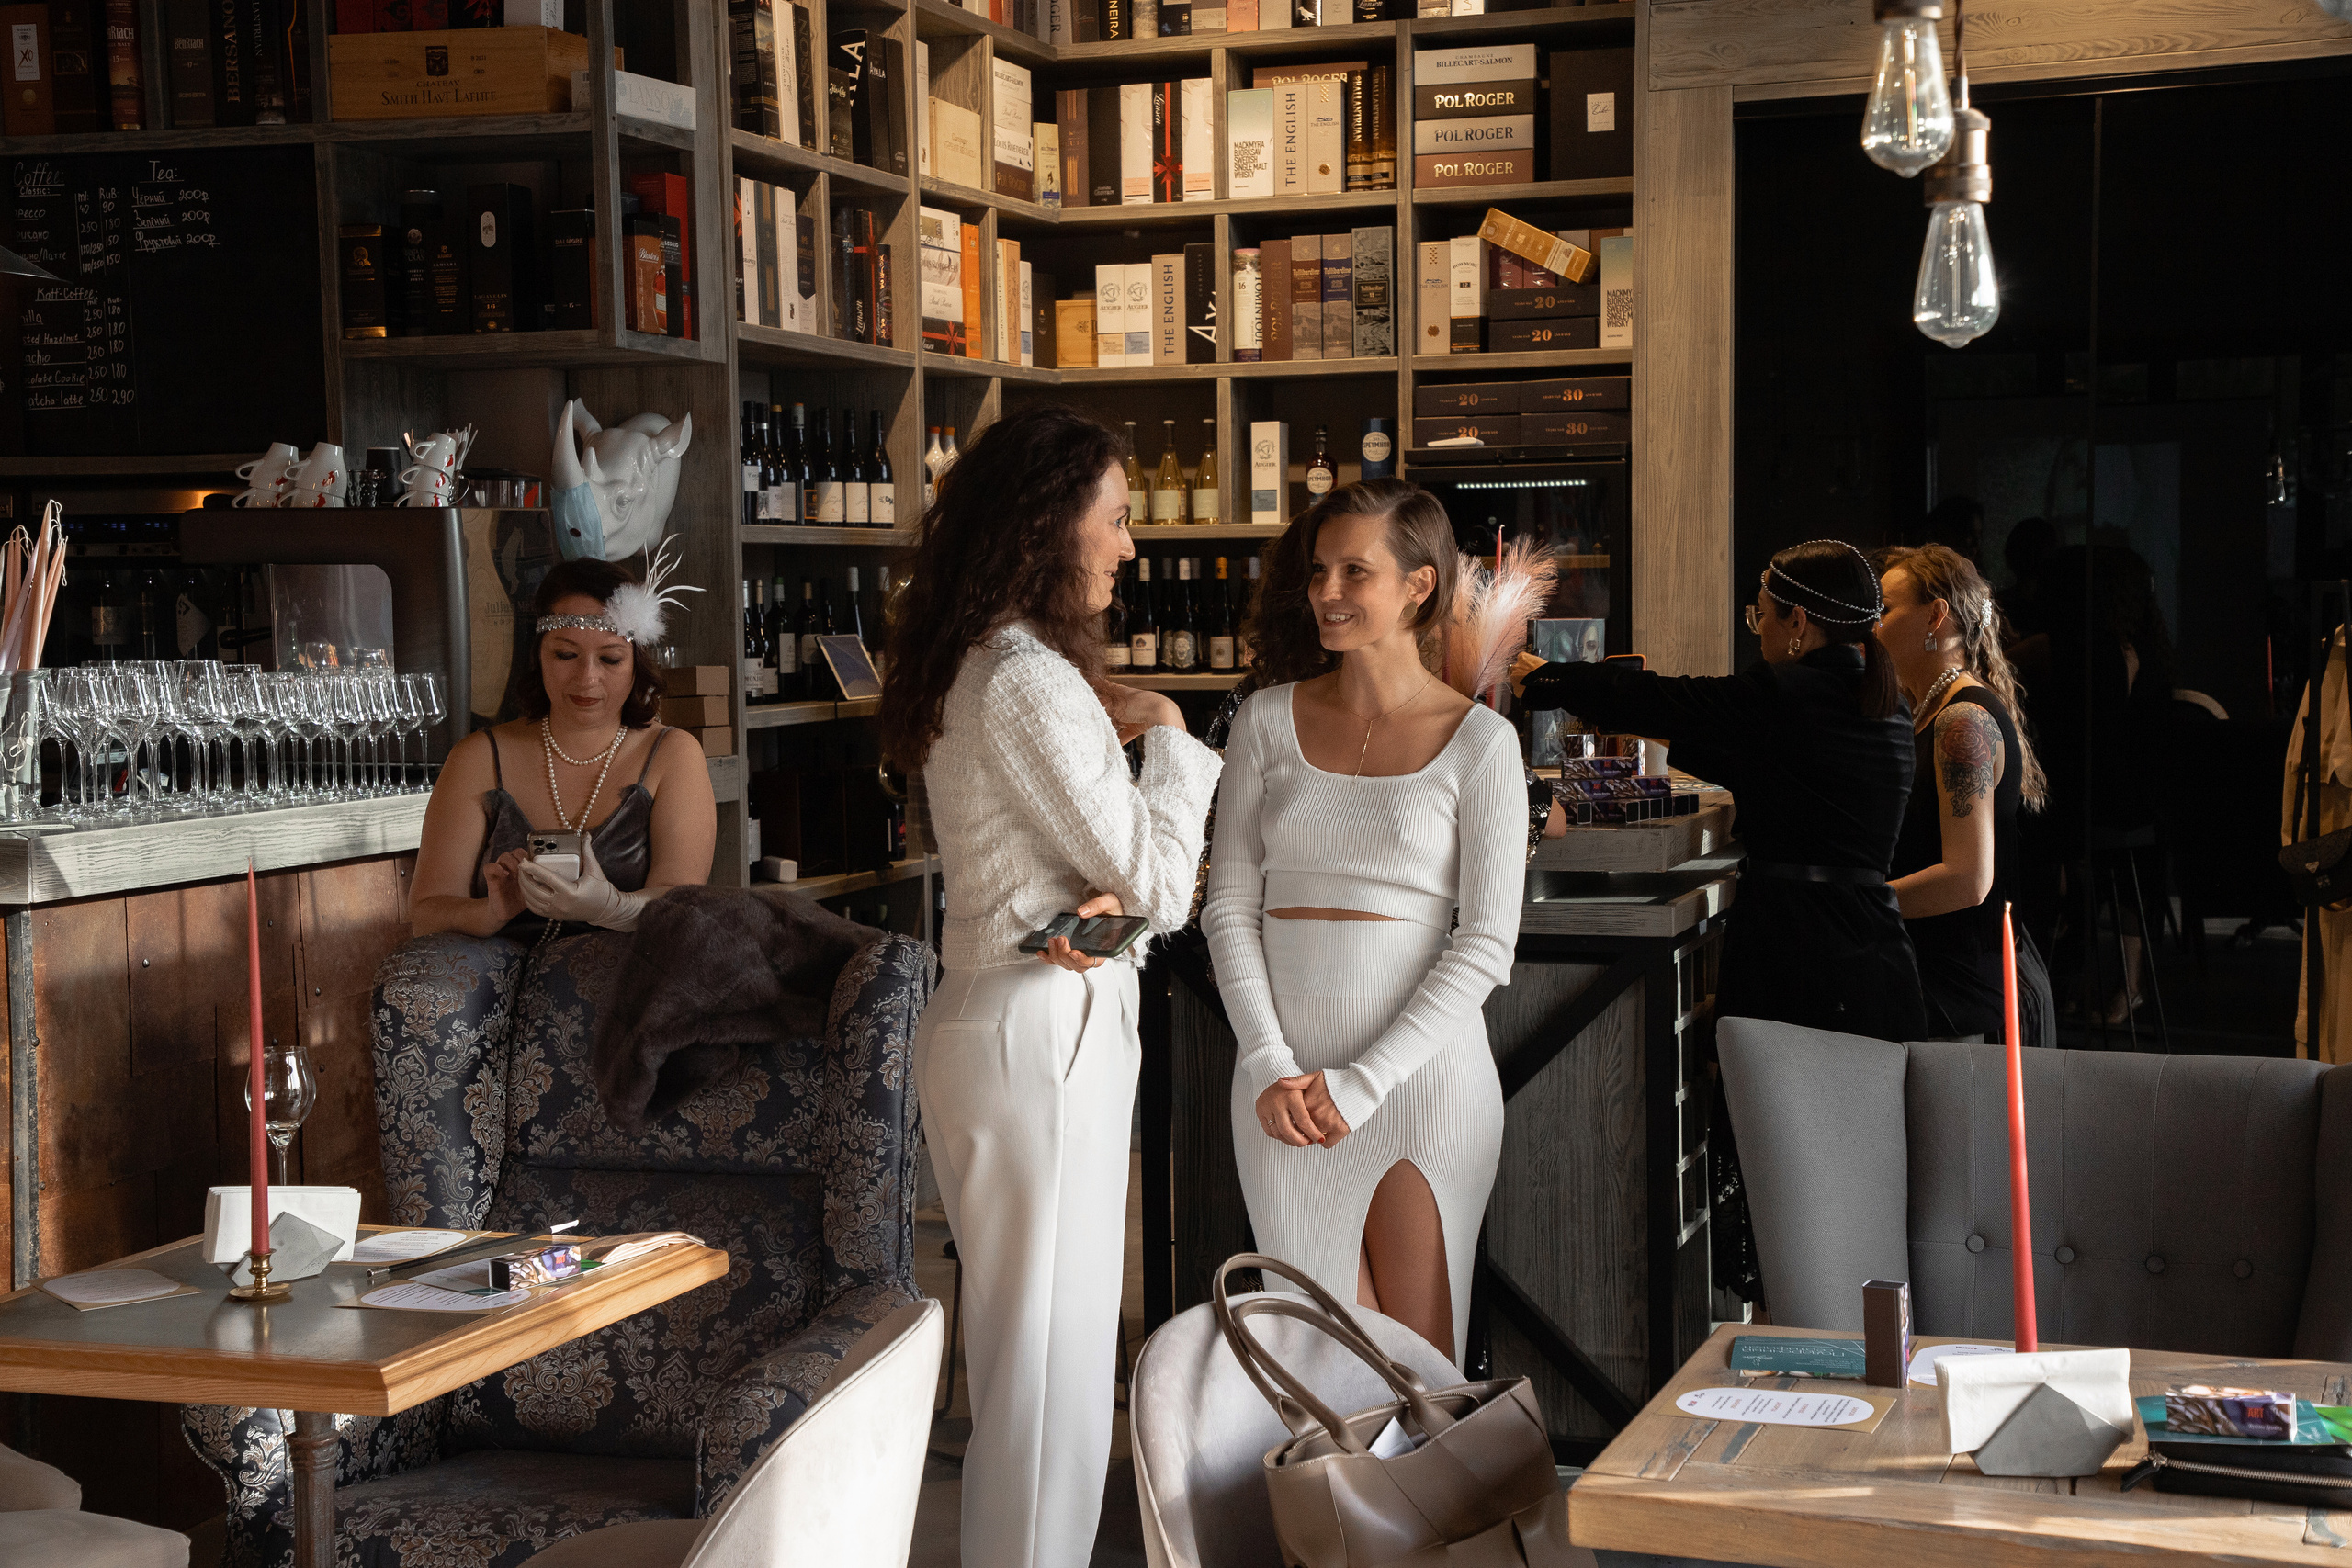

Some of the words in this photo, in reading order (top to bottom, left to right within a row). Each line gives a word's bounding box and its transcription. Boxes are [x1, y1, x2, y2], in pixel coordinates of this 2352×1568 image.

[222, 1, 241, 103] BERSANO
[1436, 57, 1514, 68] BILLECART-SALMON
[381, 90, 418, 106] SMITH
[1434, 94, 1464, 109] POL
[1464, 91, 1515, 107] ROGER
[1285, 92, 1296, 154] ENGLISH
[1435, 129, 1463, 142] POL
[1464, 126, 1514, 141] ROGER
[1234, 141, 1265, 150] MACKMYRA
[1234, 155, 1258, 164] SWEDISH
[1253, 162, 1268, 171] MALT
[149, 160, 178, 182] Tea:
[1234, 171, 1255, 179] WHISKY
[1285, 159, 1296, 187] THE
[1434, 164, 1463, 178] POL
[1464, 161, 1514, 176] ROGER
[102, 201, 115, 213] 90
[81, 221, 98, 233] 250
[105, 218, 120, 231] 180
[106, 235, 119, 248] 150
[107, 254, 121, 265] 150
[1163, 265, 1174, 323] ENGLISH
[1607, 289, 1633, 298] MACKMY
[1534, 296, 1555, 309] 20
[85, 308, 103, 321] 250
[107, 306, 121, 315] 180
[43, 333, 79, 344] Hazelnut
[86, 326, 103, 339] 250
[108, 322, 126, 337] 180
[1532, 329, 1553, 342] 20
[1164, 328, 1174, 356] THE
[25, 349, 51, 364] achio
[87, 346, 105, 360] 250
[109, 340, 124, 354] 180
[54, 370, 85, 384] Cookie
[88, 367, 107, 379] 250
[111, 362, 127, 379] 180
[28, 390, 84, 406] atcha-latte
[89, 386, 108, 403] 250
[111, 389, 135, 405] 290
[1459, 393, 1479, 406] 20
[1563, 389, 1583, 401] 30
[1458, 426, 1479, 438] 20
[1566, 423, 1588, 435] 30
